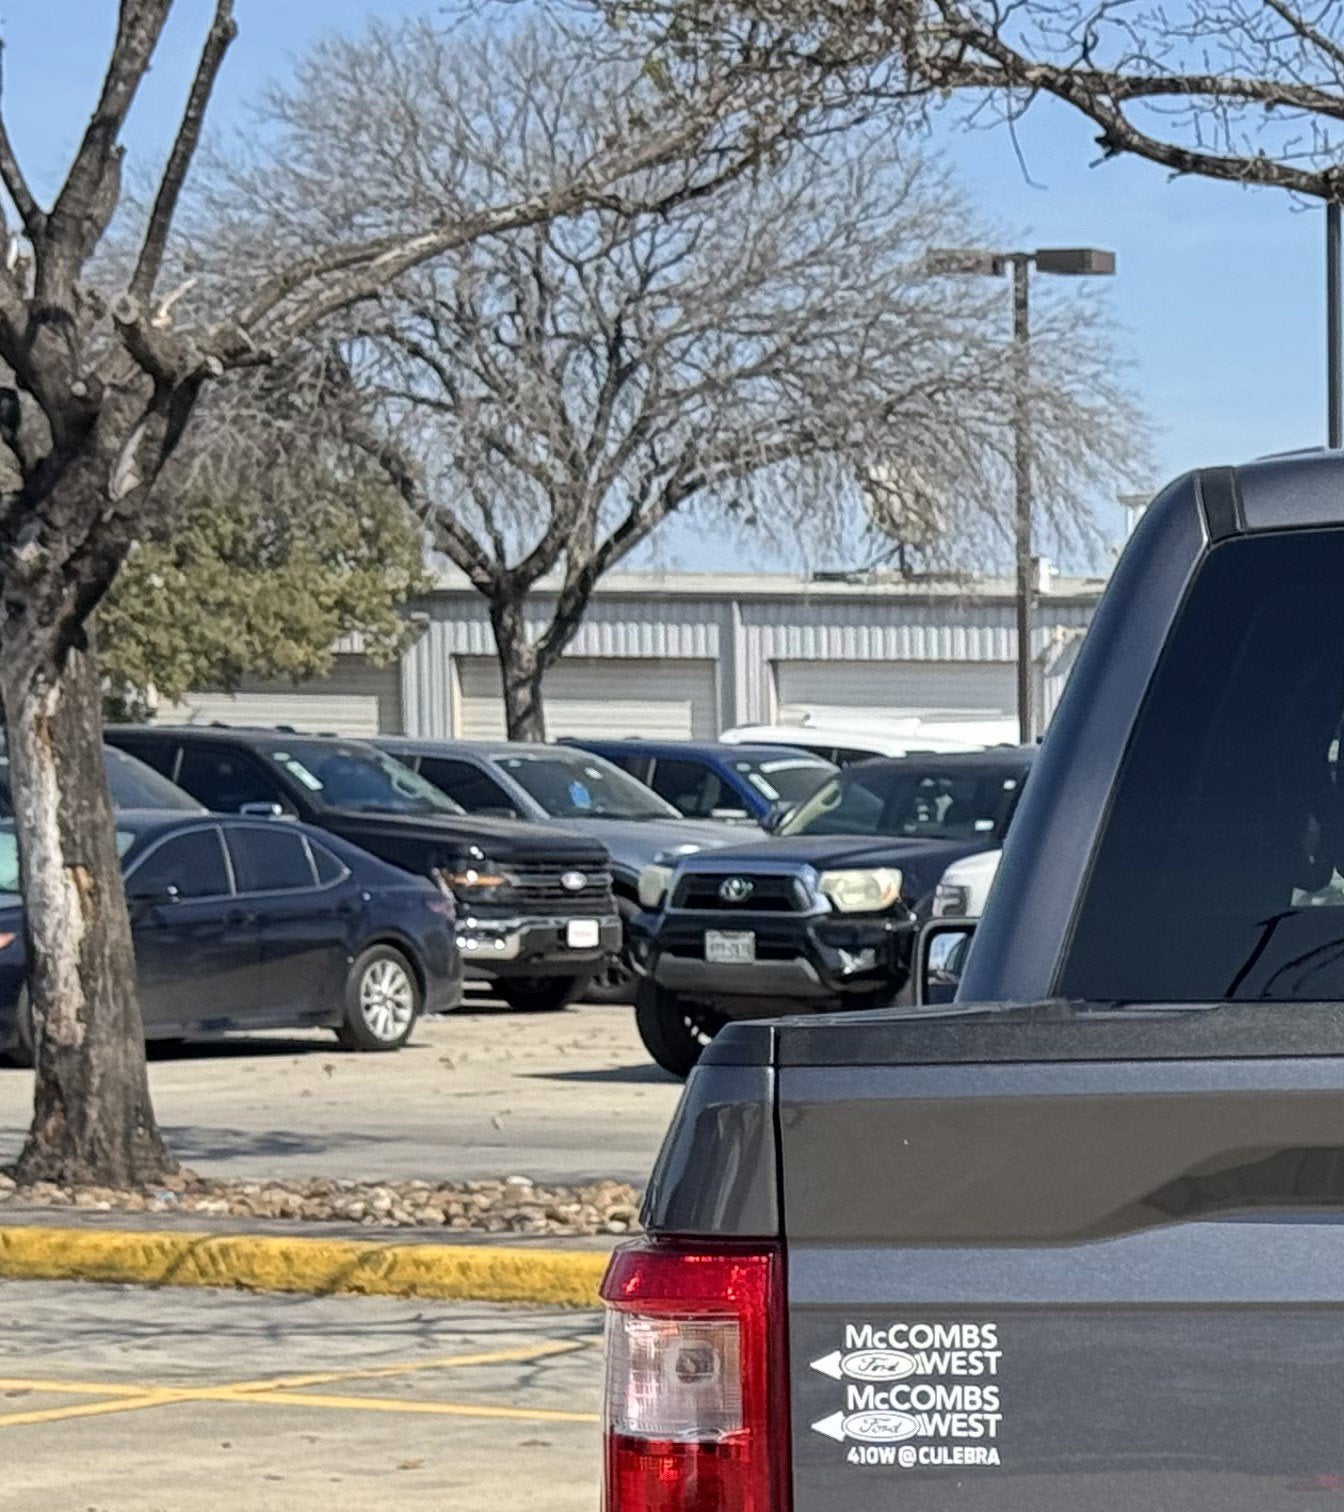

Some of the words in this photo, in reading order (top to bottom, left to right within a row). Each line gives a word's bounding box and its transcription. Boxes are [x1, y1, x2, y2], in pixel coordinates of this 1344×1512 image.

[845, 1323, 998, 1349] McCOMBS
[924, 1351, 1002, 1375] WEST
[847, 1384, 1000, 1411] McCOMBS
[925, 1412, 1002, 1437] WEST
